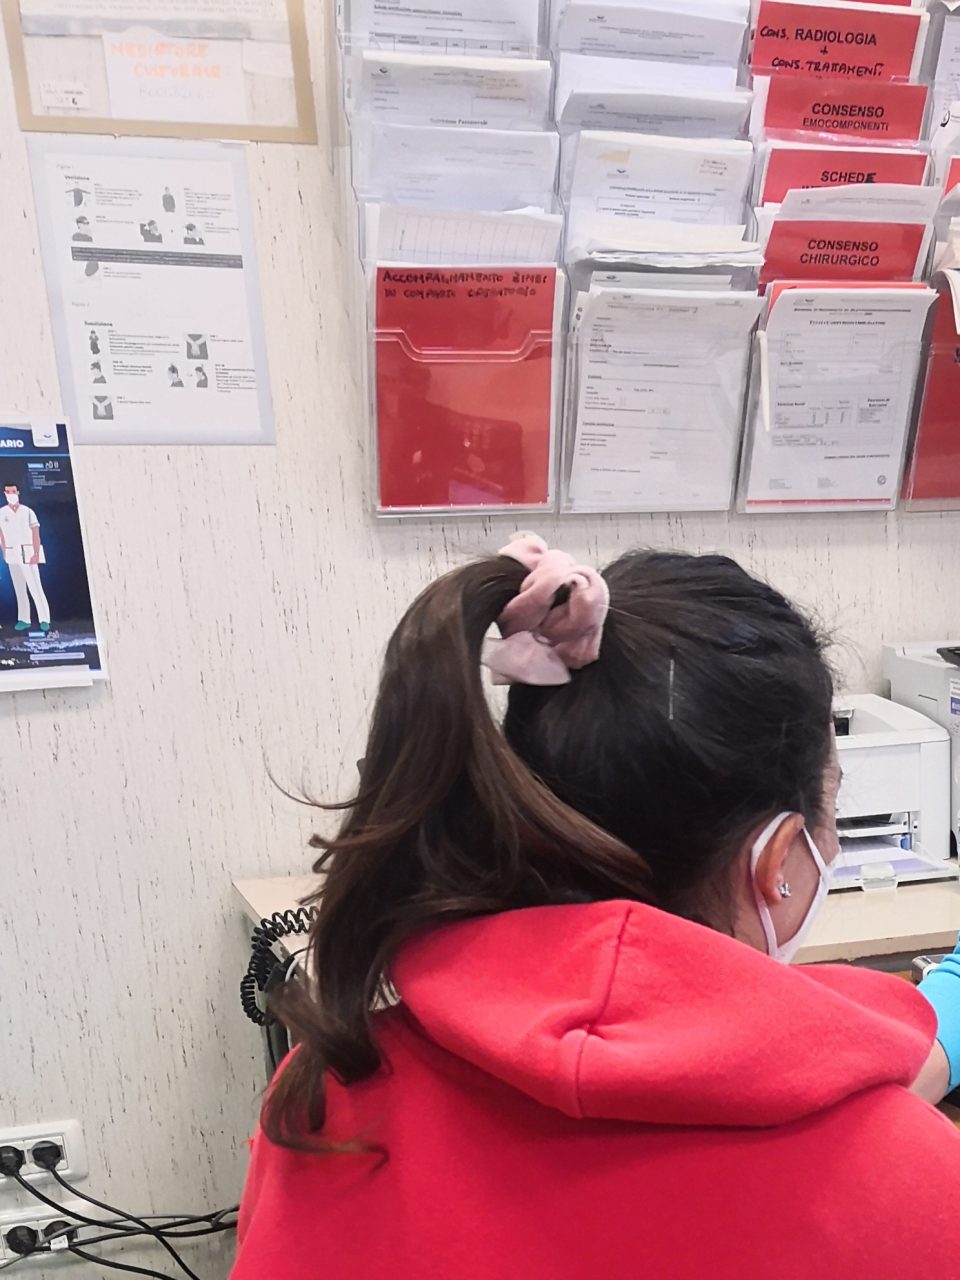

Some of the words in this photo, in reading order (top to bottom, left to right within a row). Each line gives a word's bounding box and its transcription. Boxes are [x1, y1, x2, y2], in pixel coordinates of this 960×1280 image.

[794, 28, 877, 46] RADIOLOGIA
[811, 103, 884, 119] CONSENSO
[820, 170, 877, 184] SCHEDE
[807, 239, 879, 252] CONSENSO
[799, 253, 880, 267] CHIRURGICO
